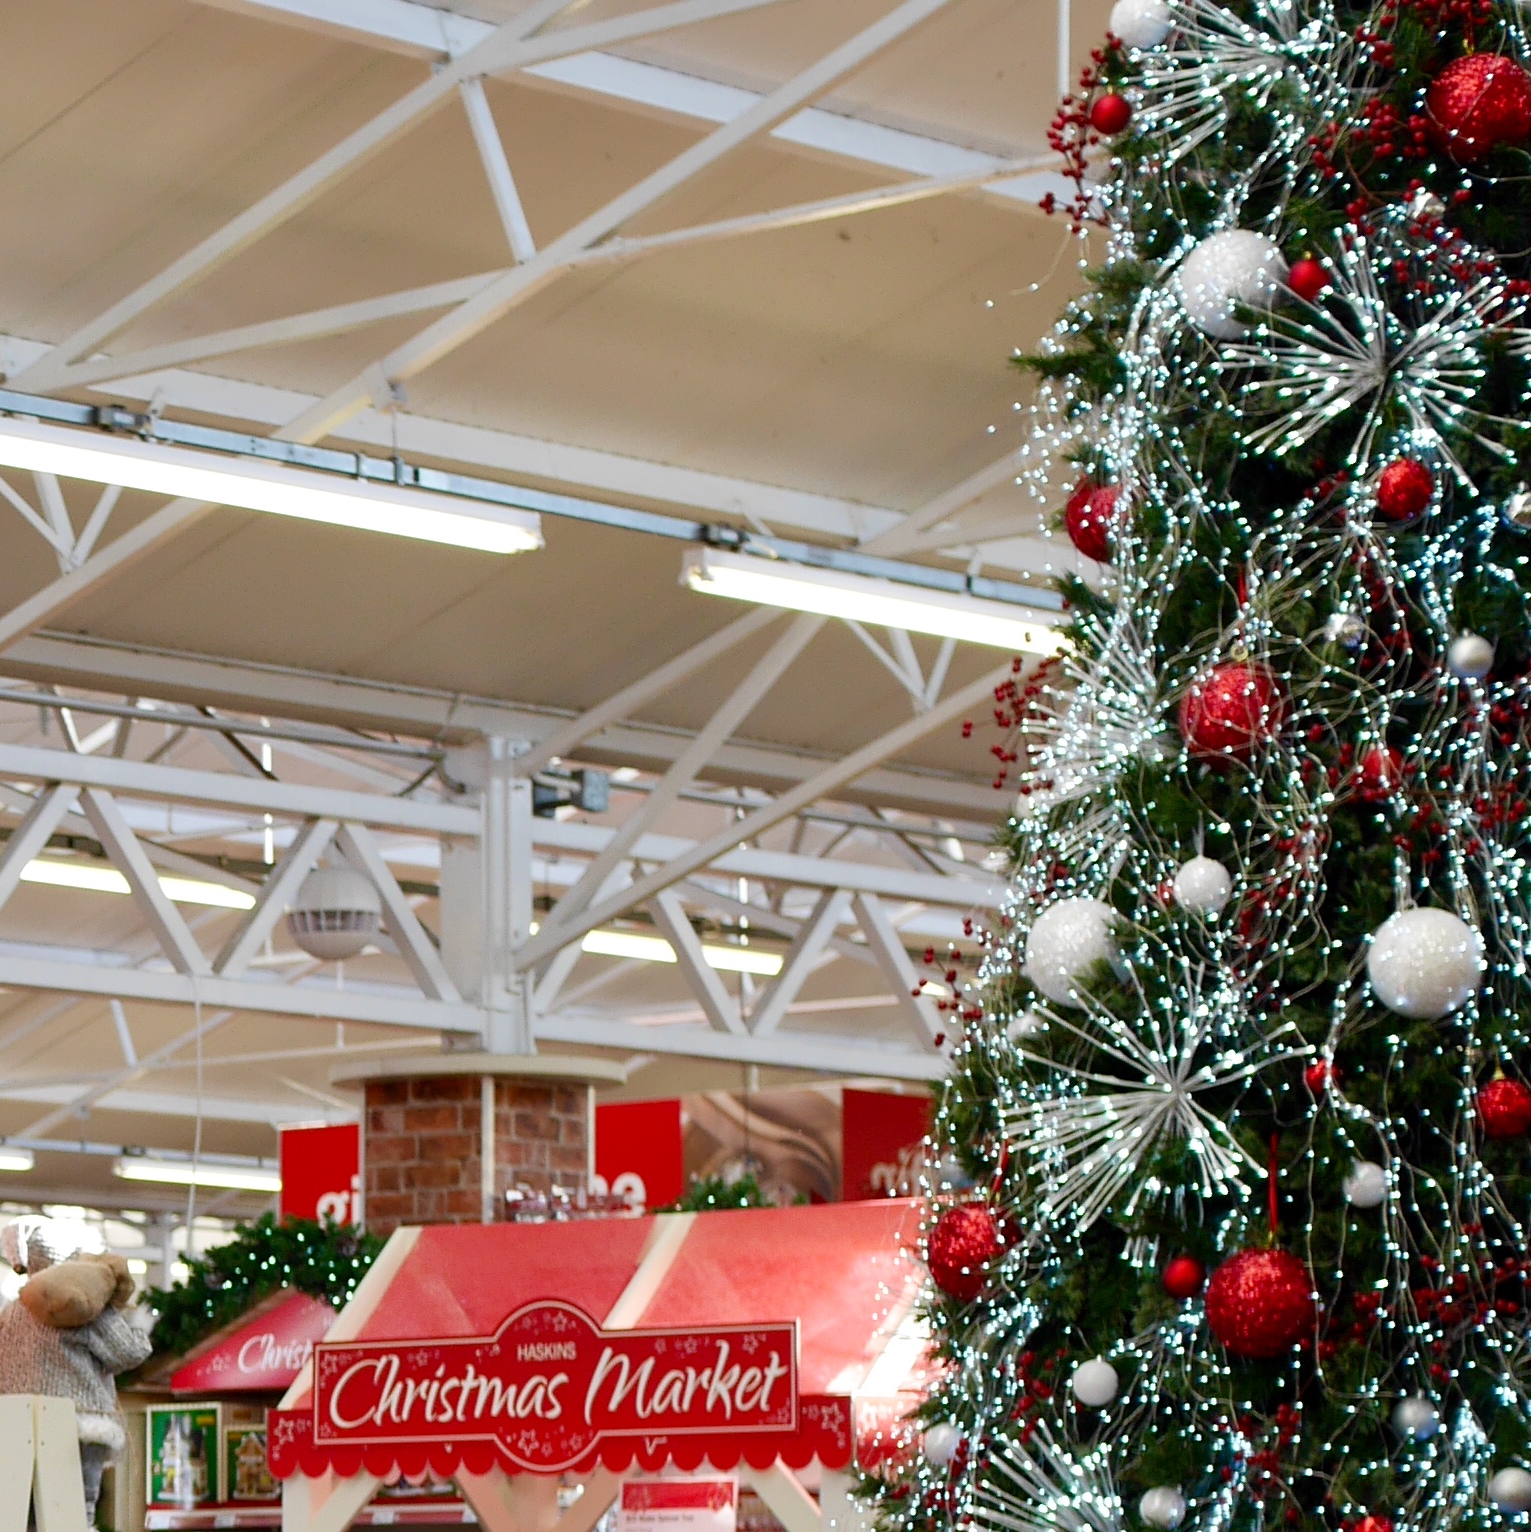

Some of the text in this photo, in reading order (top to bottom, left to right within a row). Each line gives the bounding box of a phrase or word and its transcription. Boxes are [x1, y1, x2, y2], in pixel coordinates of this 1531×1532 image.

[517, 1343, 577, 1362] HASKINS
[330, 1339, 788, 1429] Christmas Market
